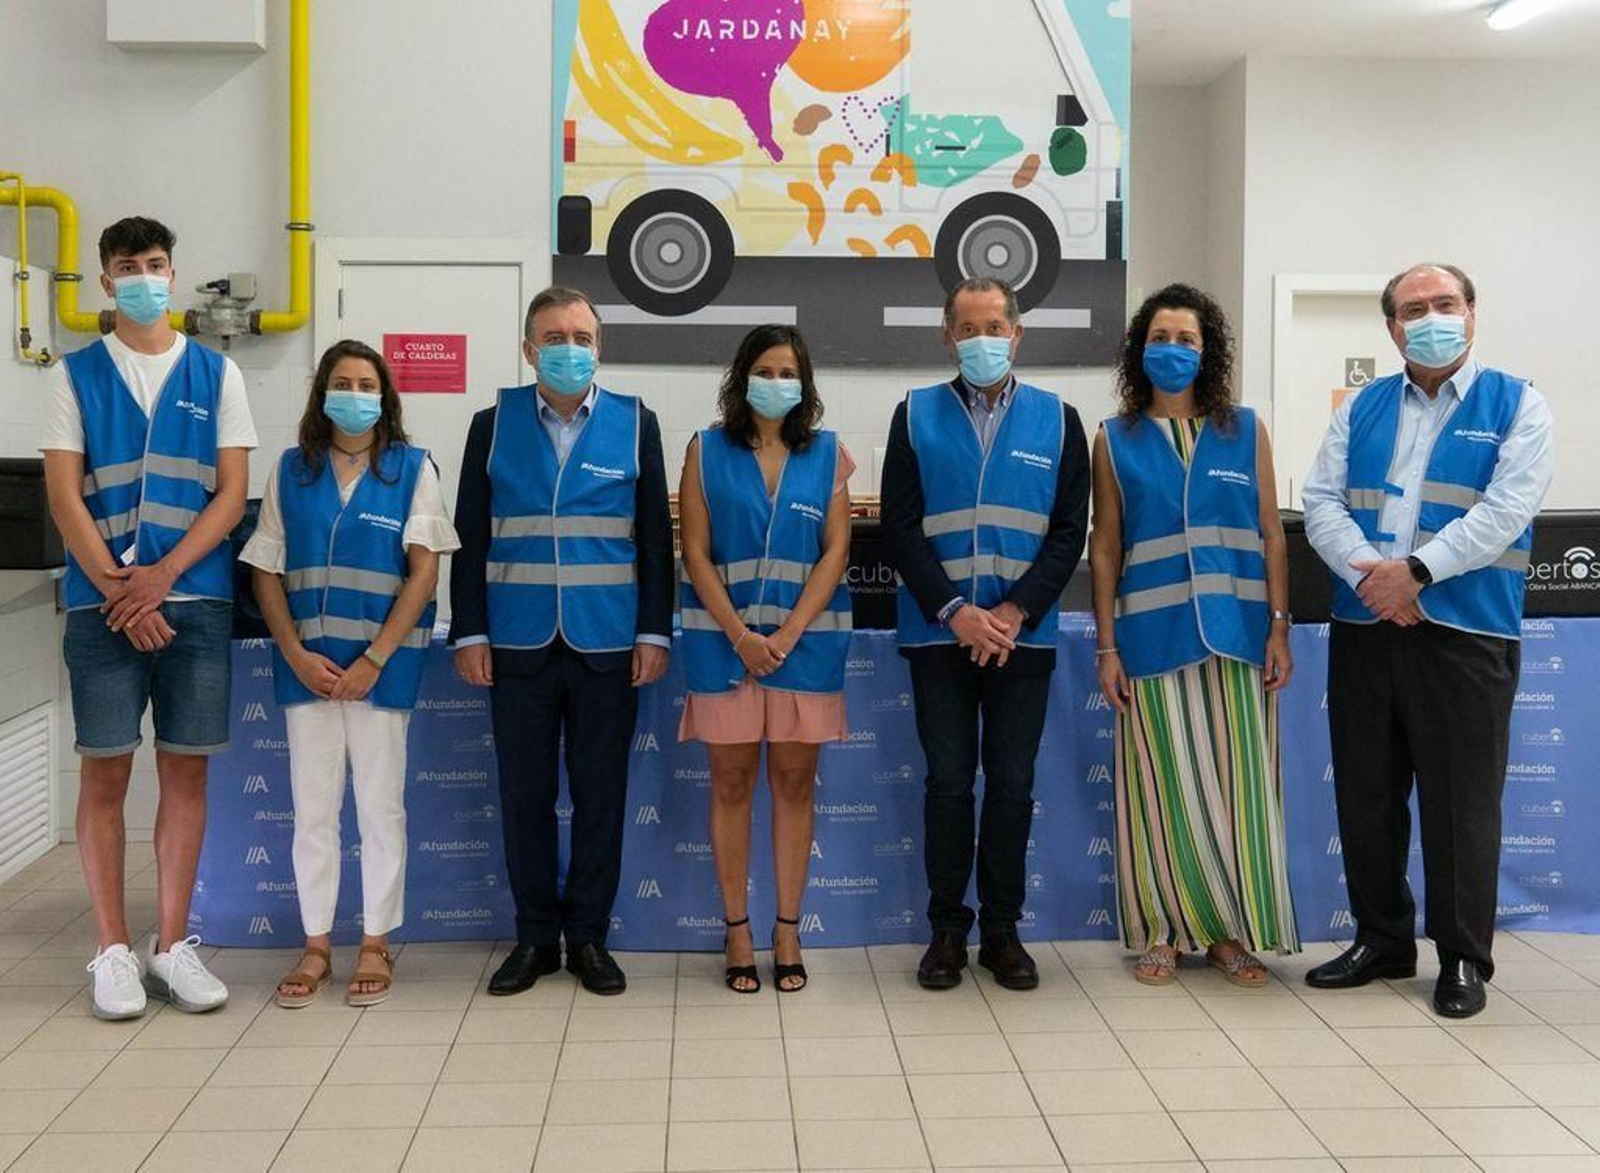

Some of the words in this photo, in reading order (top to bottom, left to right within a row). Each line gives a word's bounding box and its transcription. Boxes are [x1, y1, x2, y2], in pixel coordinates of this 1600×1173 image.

[672, 18, 851, 40] JARDANAY
[405, 342, 445, 351] CUARTO
[392, 351, 406, 360] DE
[408, 351, 457, 360] CALDERAS
